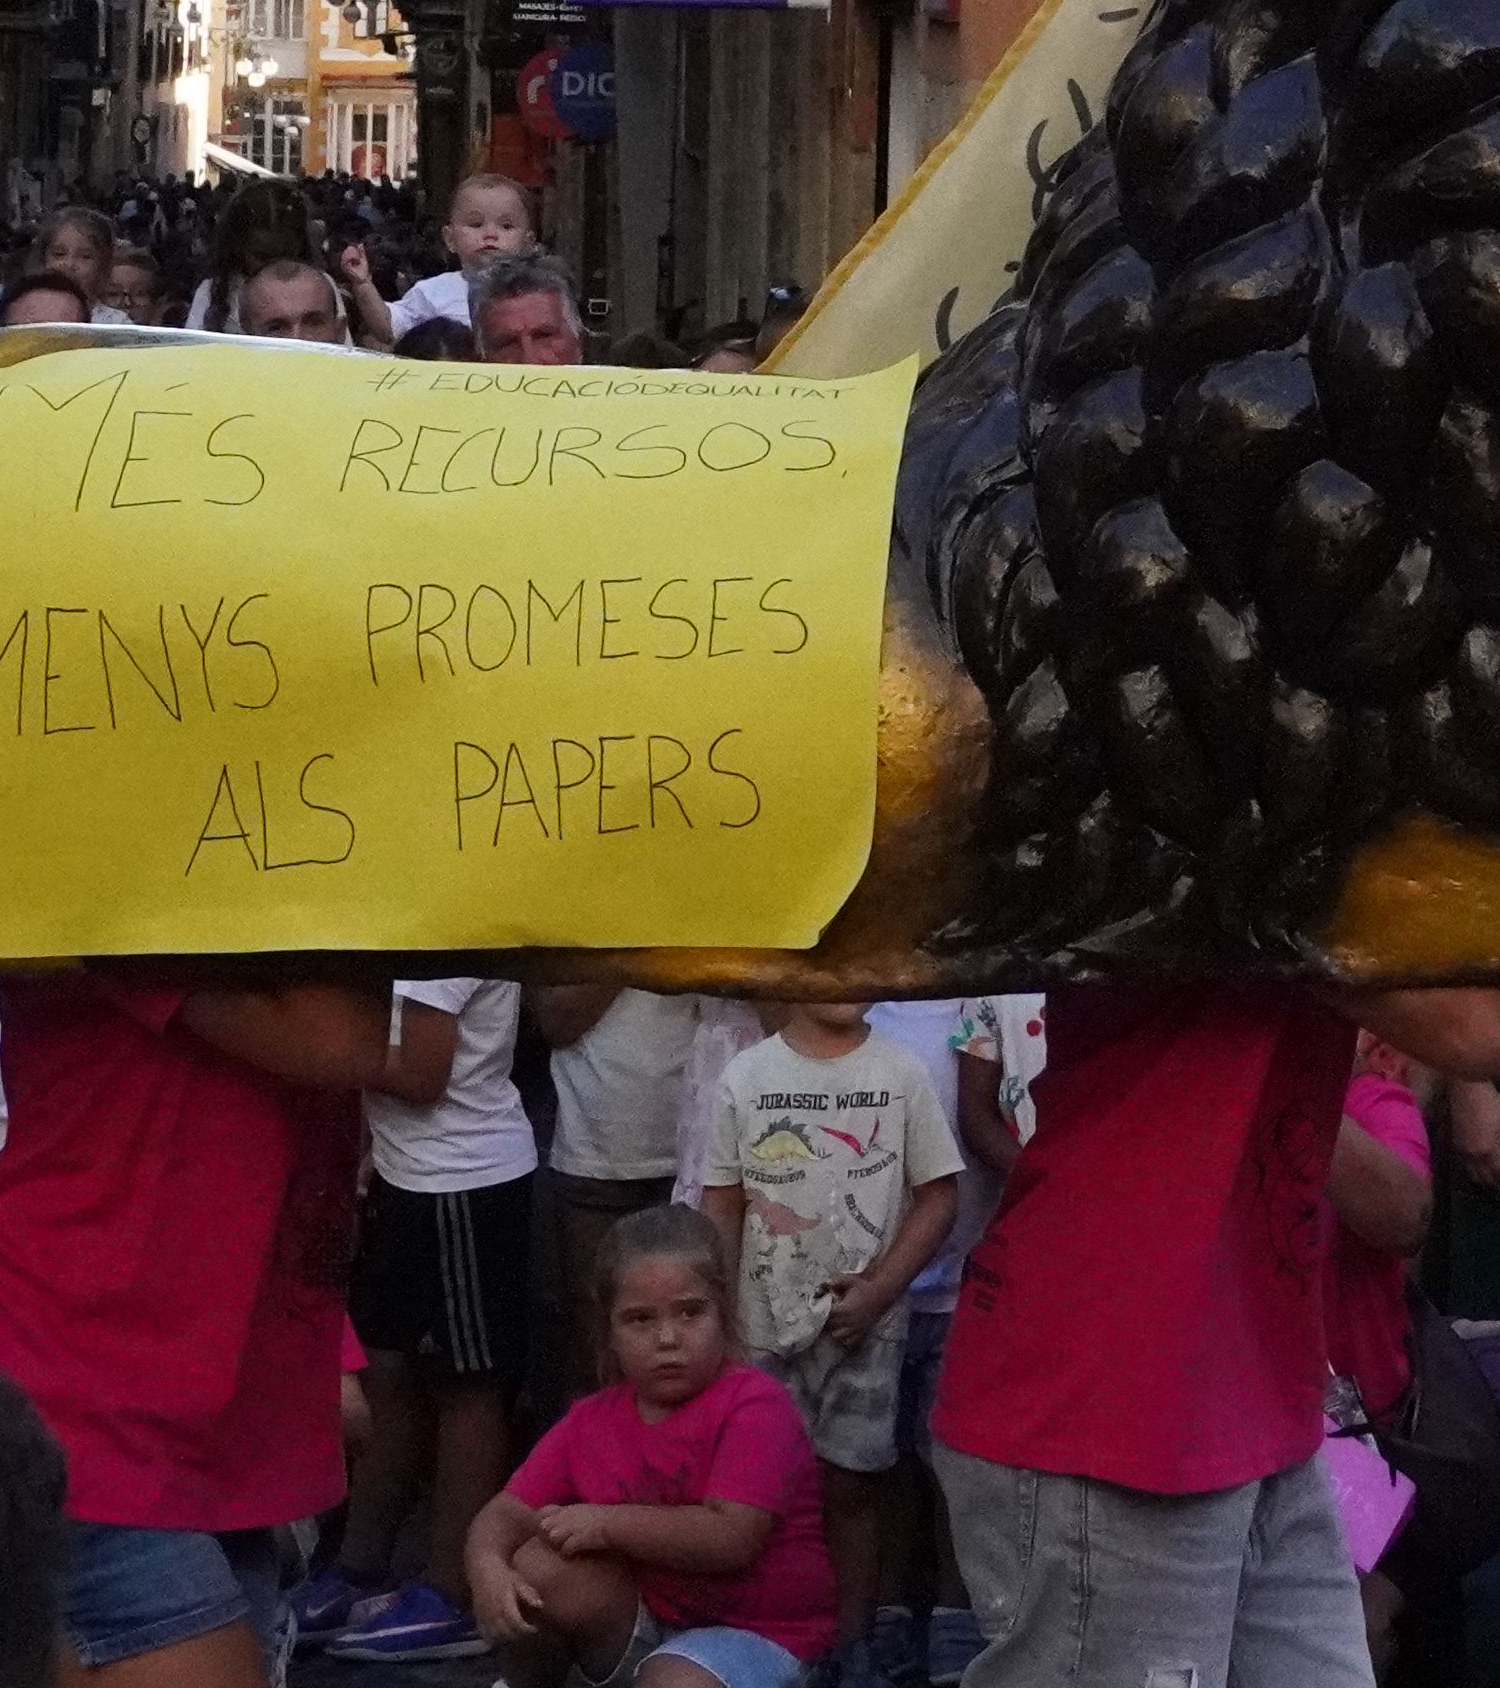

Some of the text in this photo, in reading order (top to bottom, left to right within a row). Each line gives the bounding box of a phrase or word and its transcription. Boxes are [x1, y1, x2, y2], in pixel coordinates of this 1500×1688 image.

[366, 577, 809, 685] PROMESES
[185, 728, 761, 877] ALS PAPERS
[756, 1090, 890, 1111] JURASSIC WORLD
